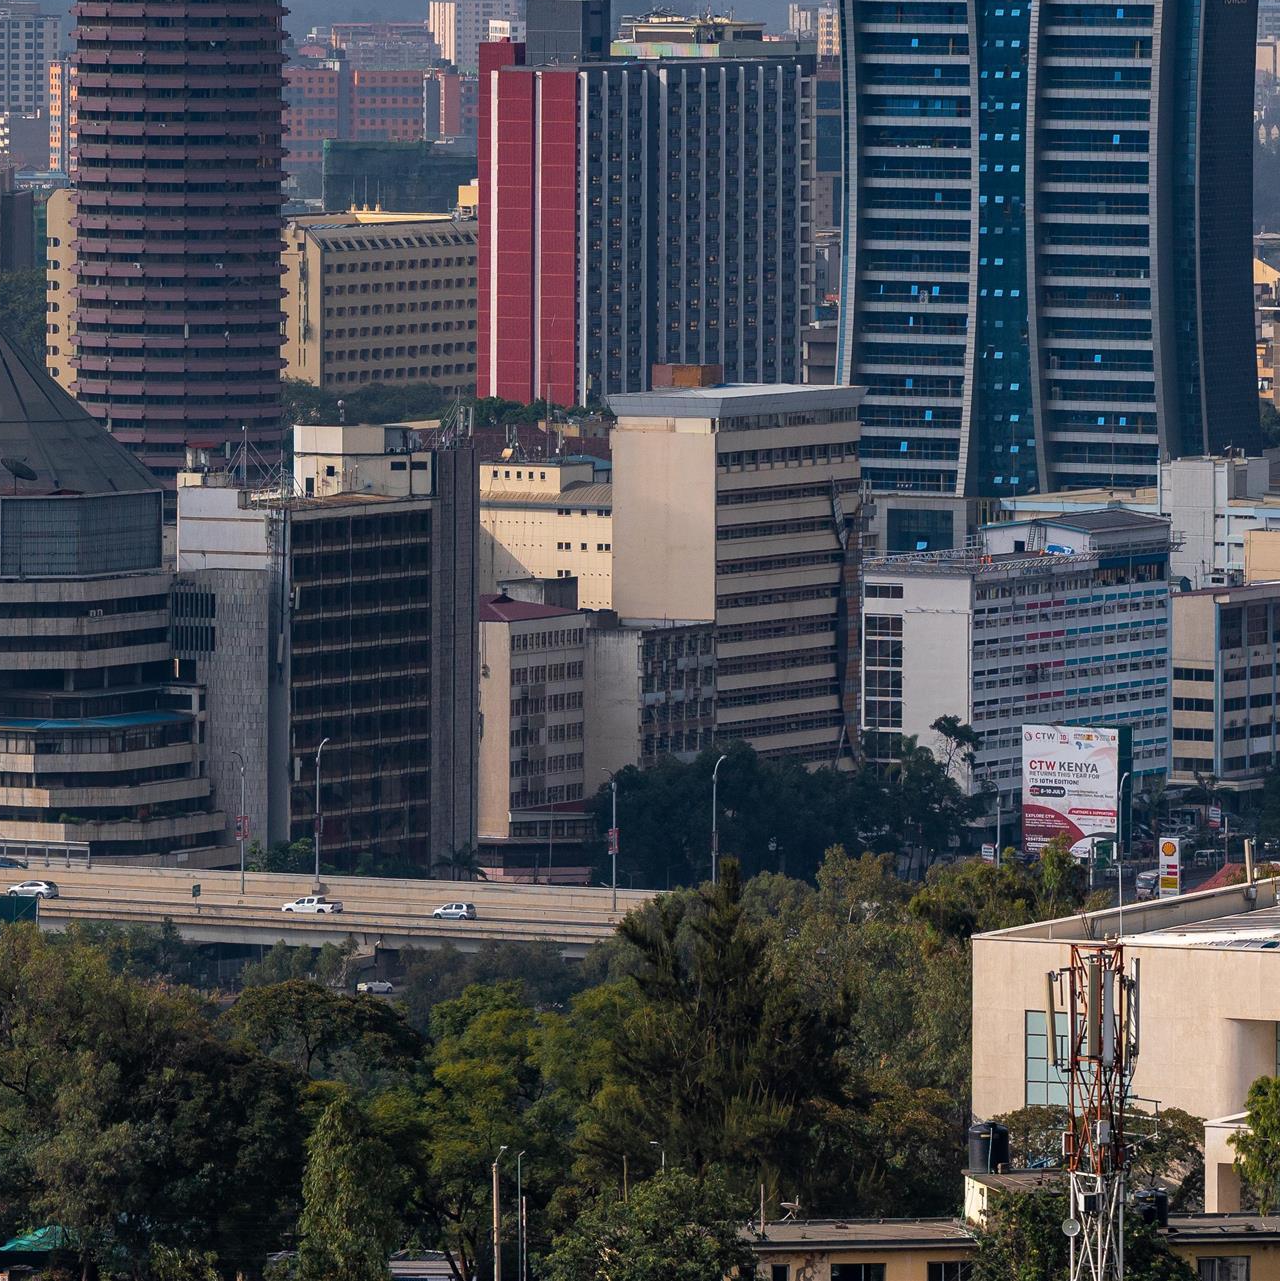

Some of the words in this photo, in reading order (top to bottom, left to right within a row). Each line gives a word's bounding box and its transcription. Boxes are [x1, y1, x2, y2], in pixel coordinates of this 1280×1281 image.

[1035, 732, 1056, 740] CTW
[1029, 760, 1056, 771] CTW
[1058, 761, 1099, 773] KENYA
